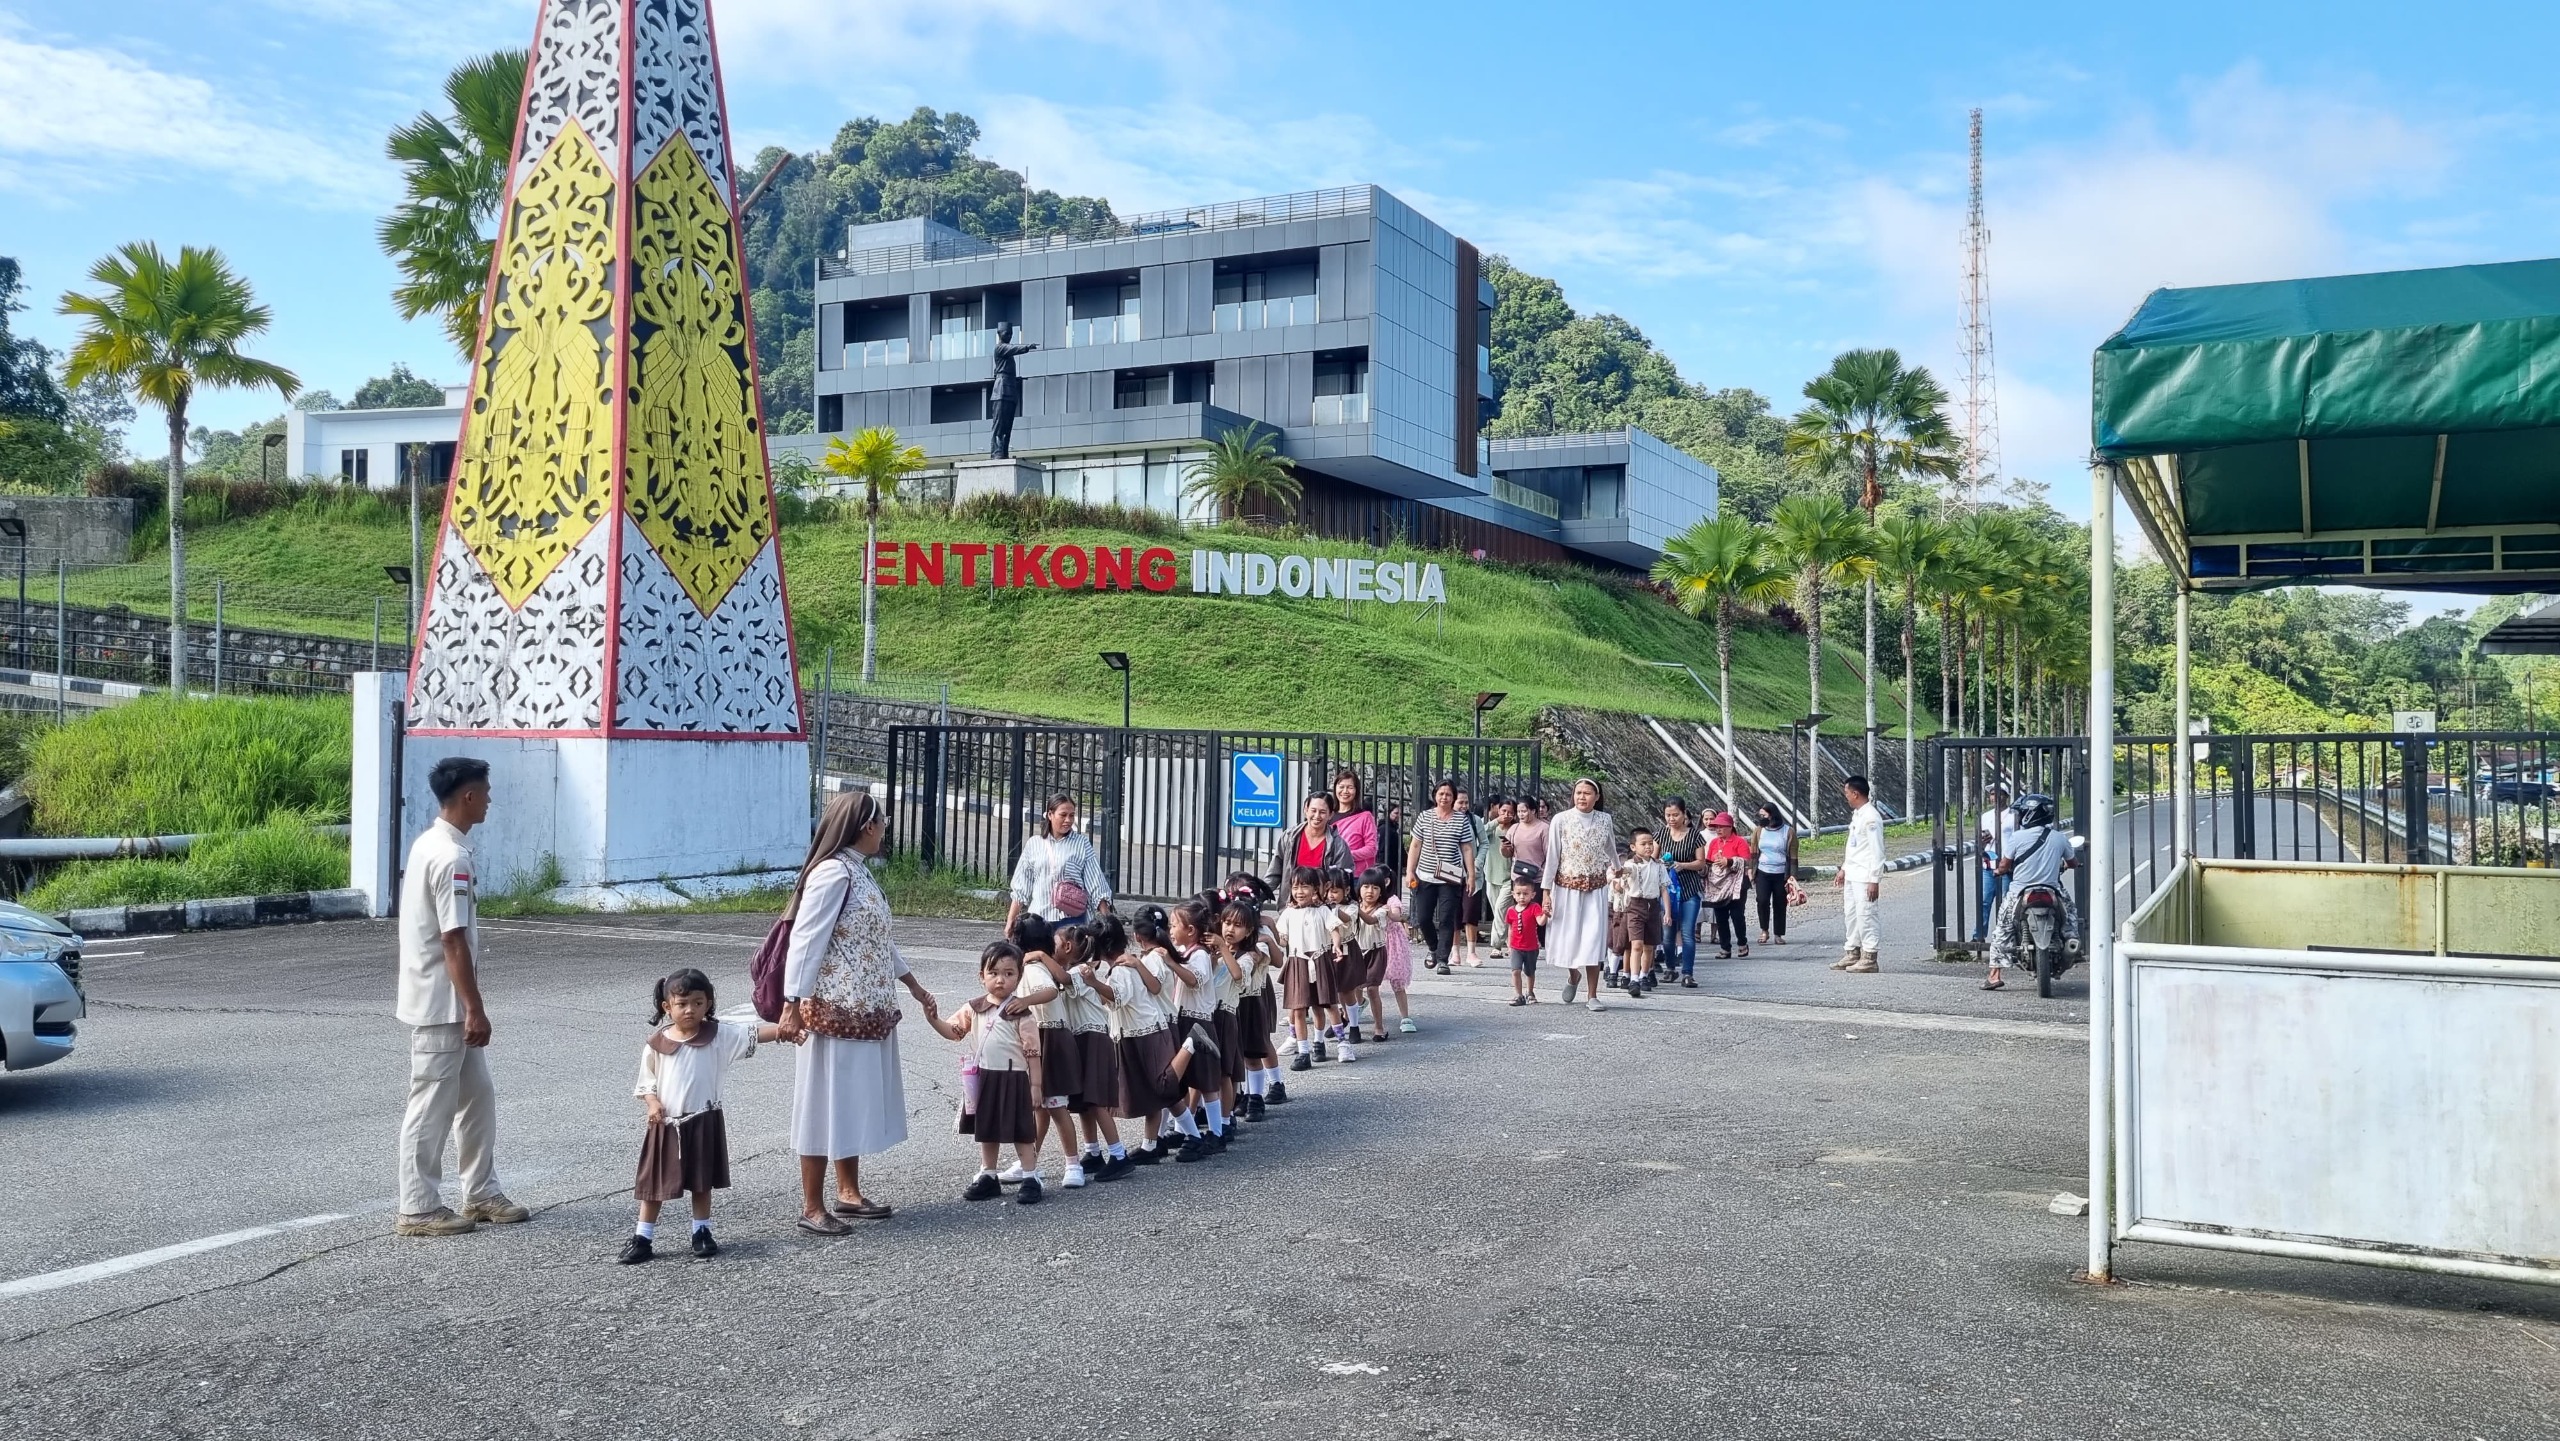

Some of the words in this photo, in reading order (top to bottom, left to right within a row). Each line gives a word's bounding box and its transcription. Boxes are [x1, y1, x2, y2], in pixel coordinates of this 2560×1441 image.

[864, 541, 1177, 592] ENTIKONG
[1192, 549, 1446, 604] INDONESIA
[1237, 808, 1275, 817] KELUAR
